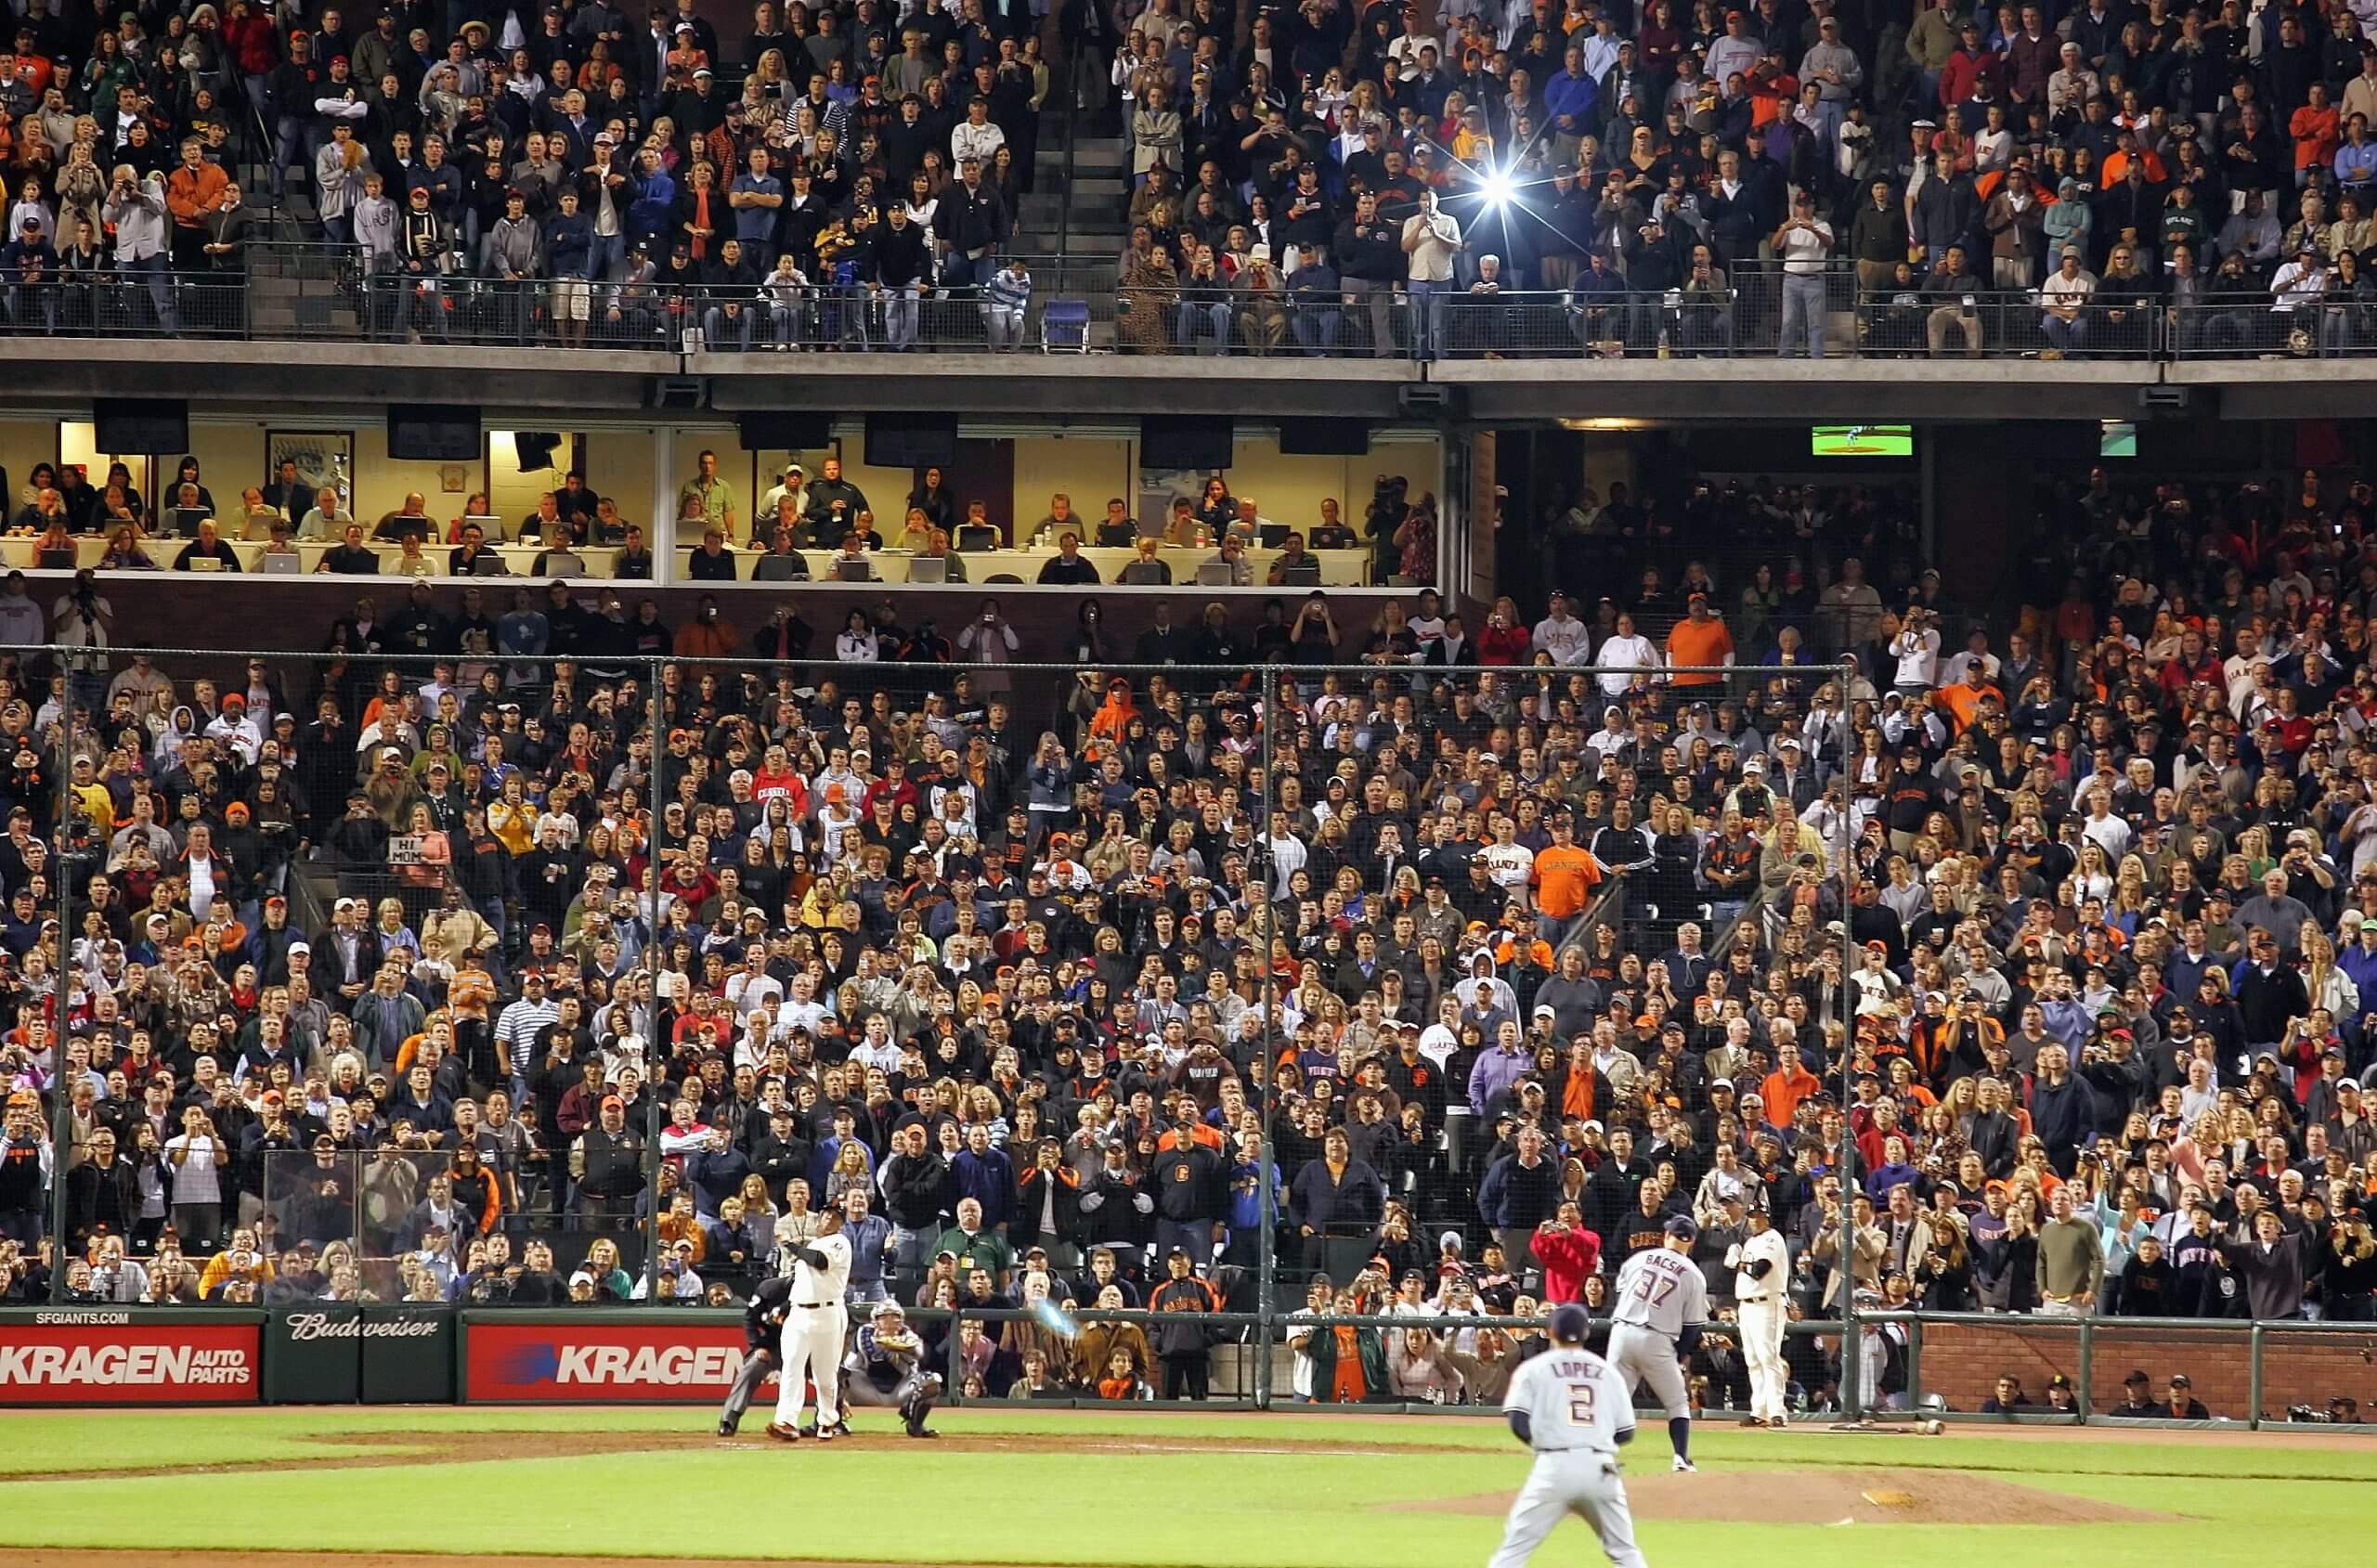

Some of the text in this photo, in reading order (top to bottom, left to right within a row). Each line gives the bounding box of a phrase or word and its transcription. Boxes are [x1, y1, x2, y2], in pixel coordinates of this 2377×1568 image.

[399, 839, 413, 849] HI
[393, 851, 422, 862] MOM
[1646, 1254, 1686, 1275] BACSIK
[1633, 1269, 1679, 1310] 37
[36, 1313, 129, 1325] SFGIANTS.COM
[286, 1313, 438, 1341] Budweiser
[0, 1345, 192, 1385] KRAGEN
[191, 1350, 245, 1367] AUTO
[188, 1367, 251, 1384] PARTS
[1551, 1361, 1604, 1380] LOPEZ
[1566, 1383, 1596, 1427] 2
